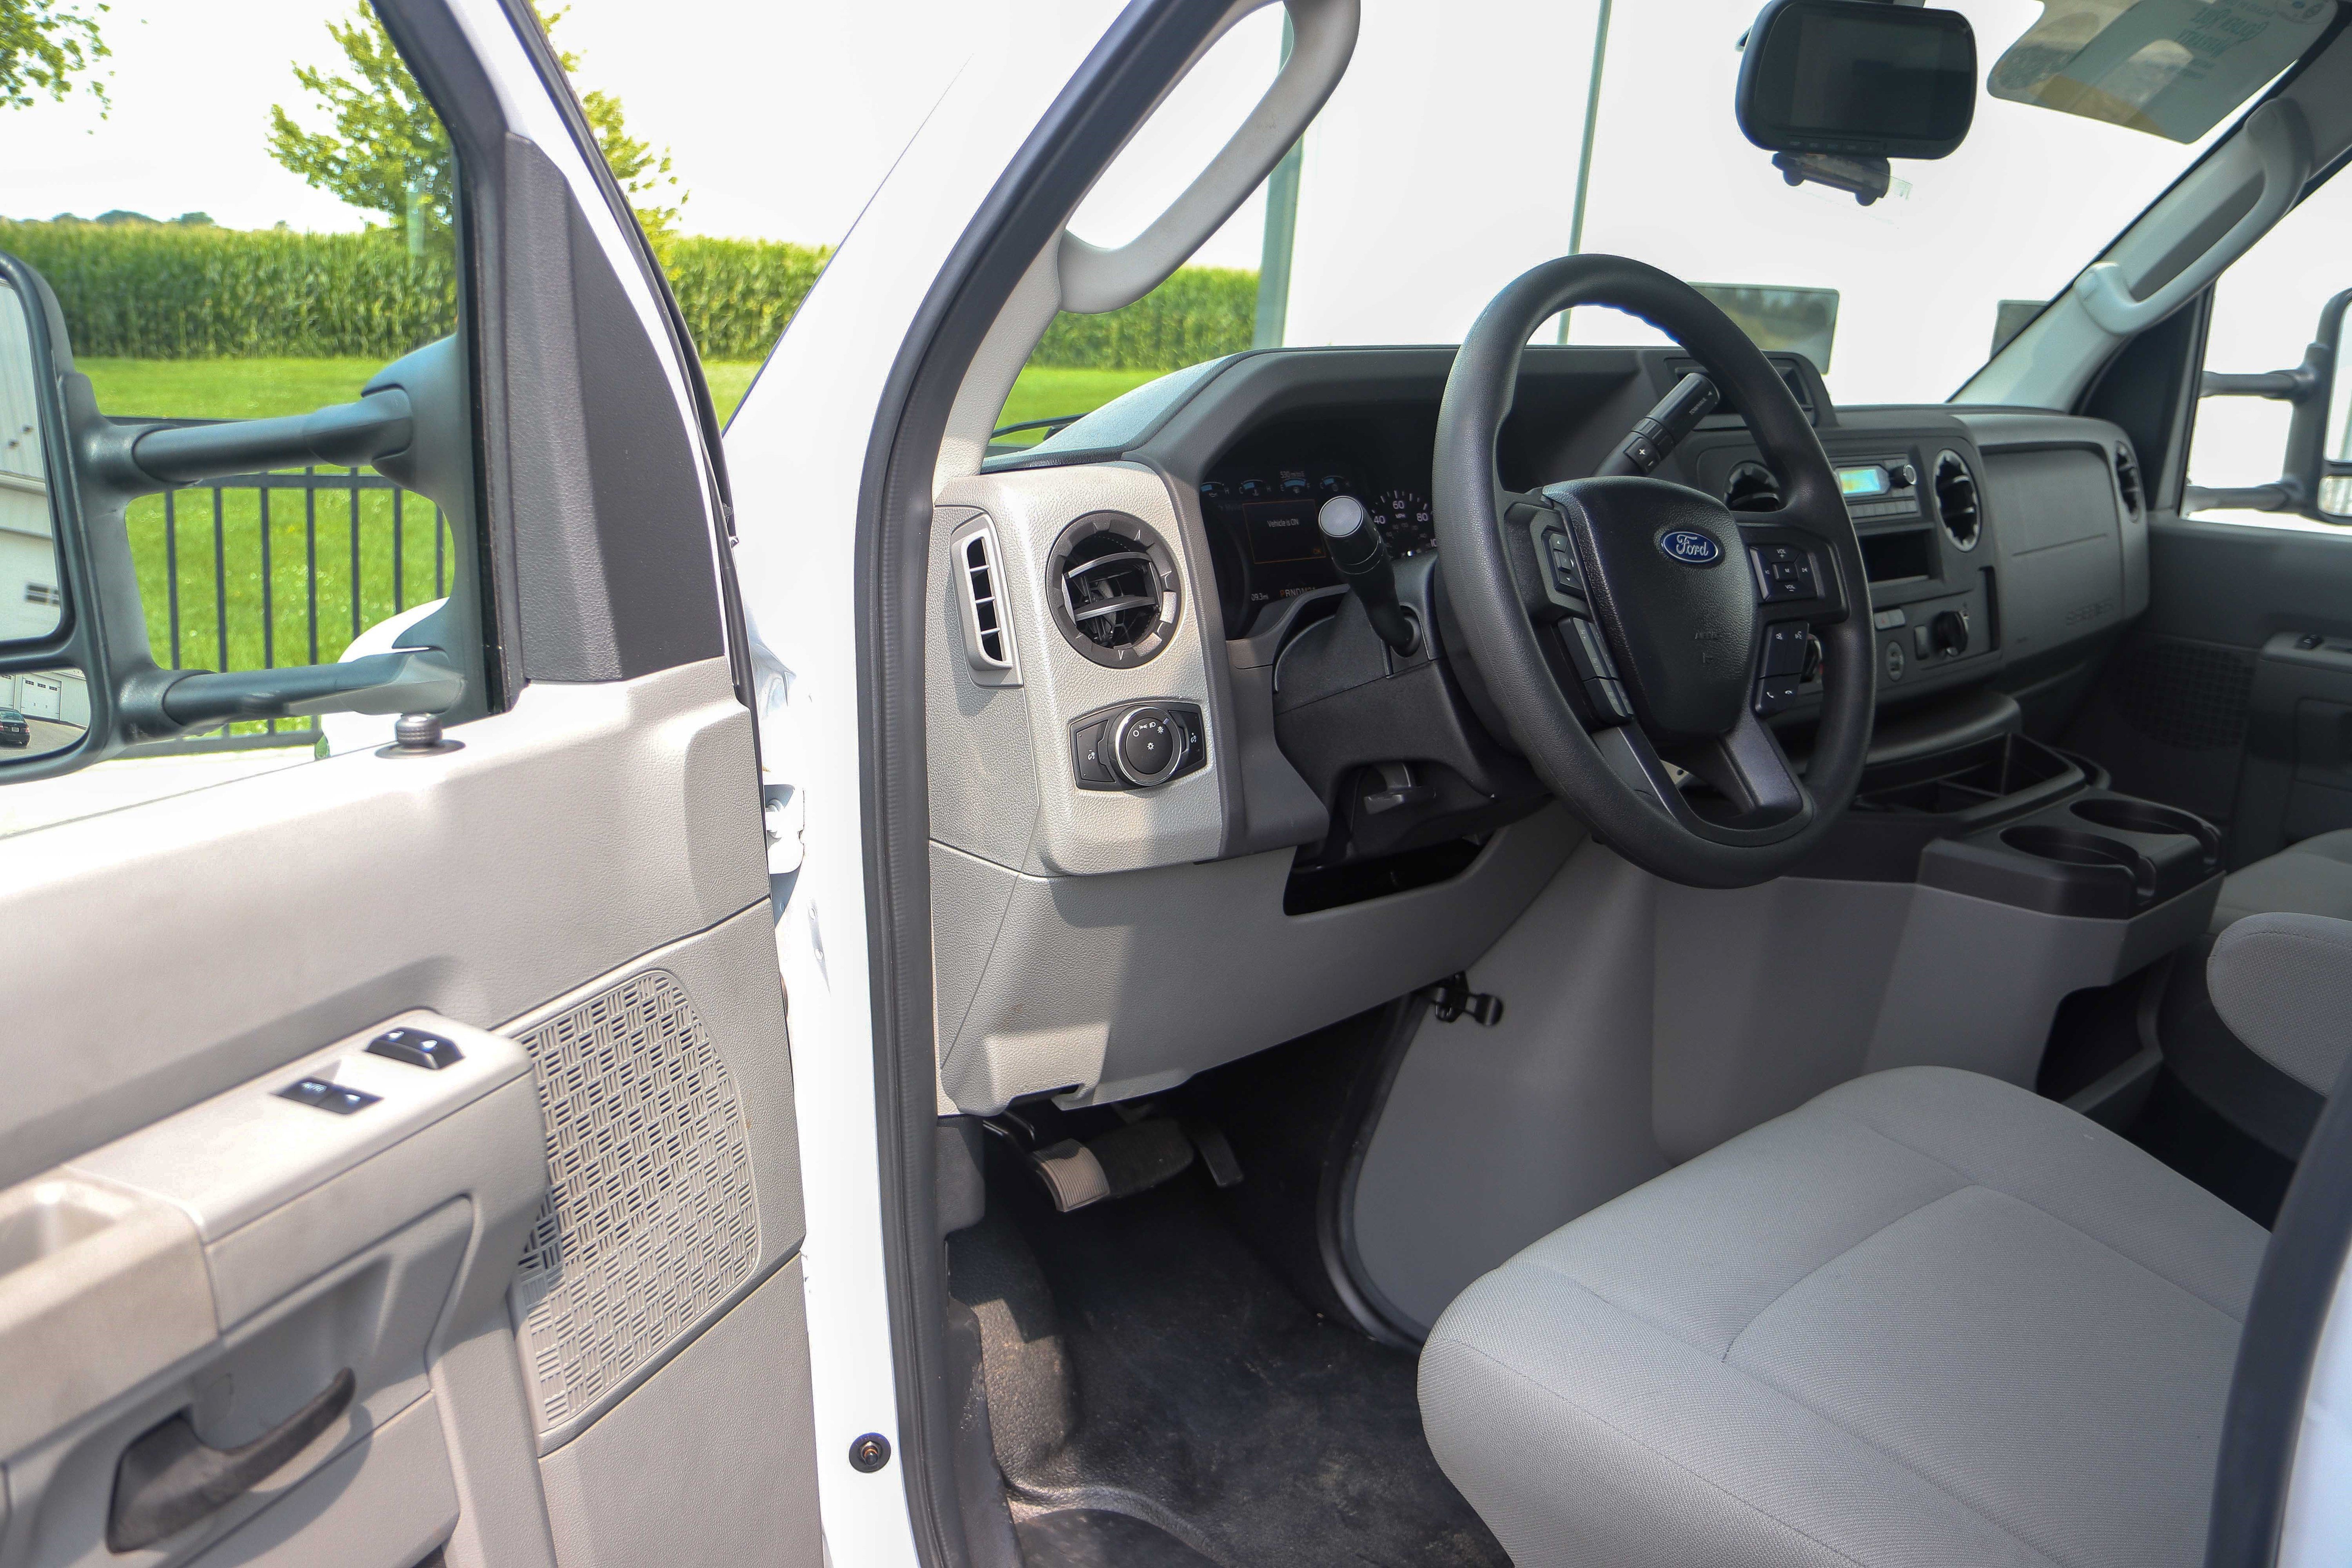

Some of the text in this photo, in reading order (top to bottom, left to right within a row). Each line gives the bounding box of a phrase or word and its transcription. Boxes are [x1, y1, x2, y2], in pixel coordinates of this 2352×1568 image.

[1392, 501, 1405, 509] 60
[1374, 515, 1385, 524] 40
[1416, 513, 1428, 521] 80
[1676, 534, 1709, 556] Ford
